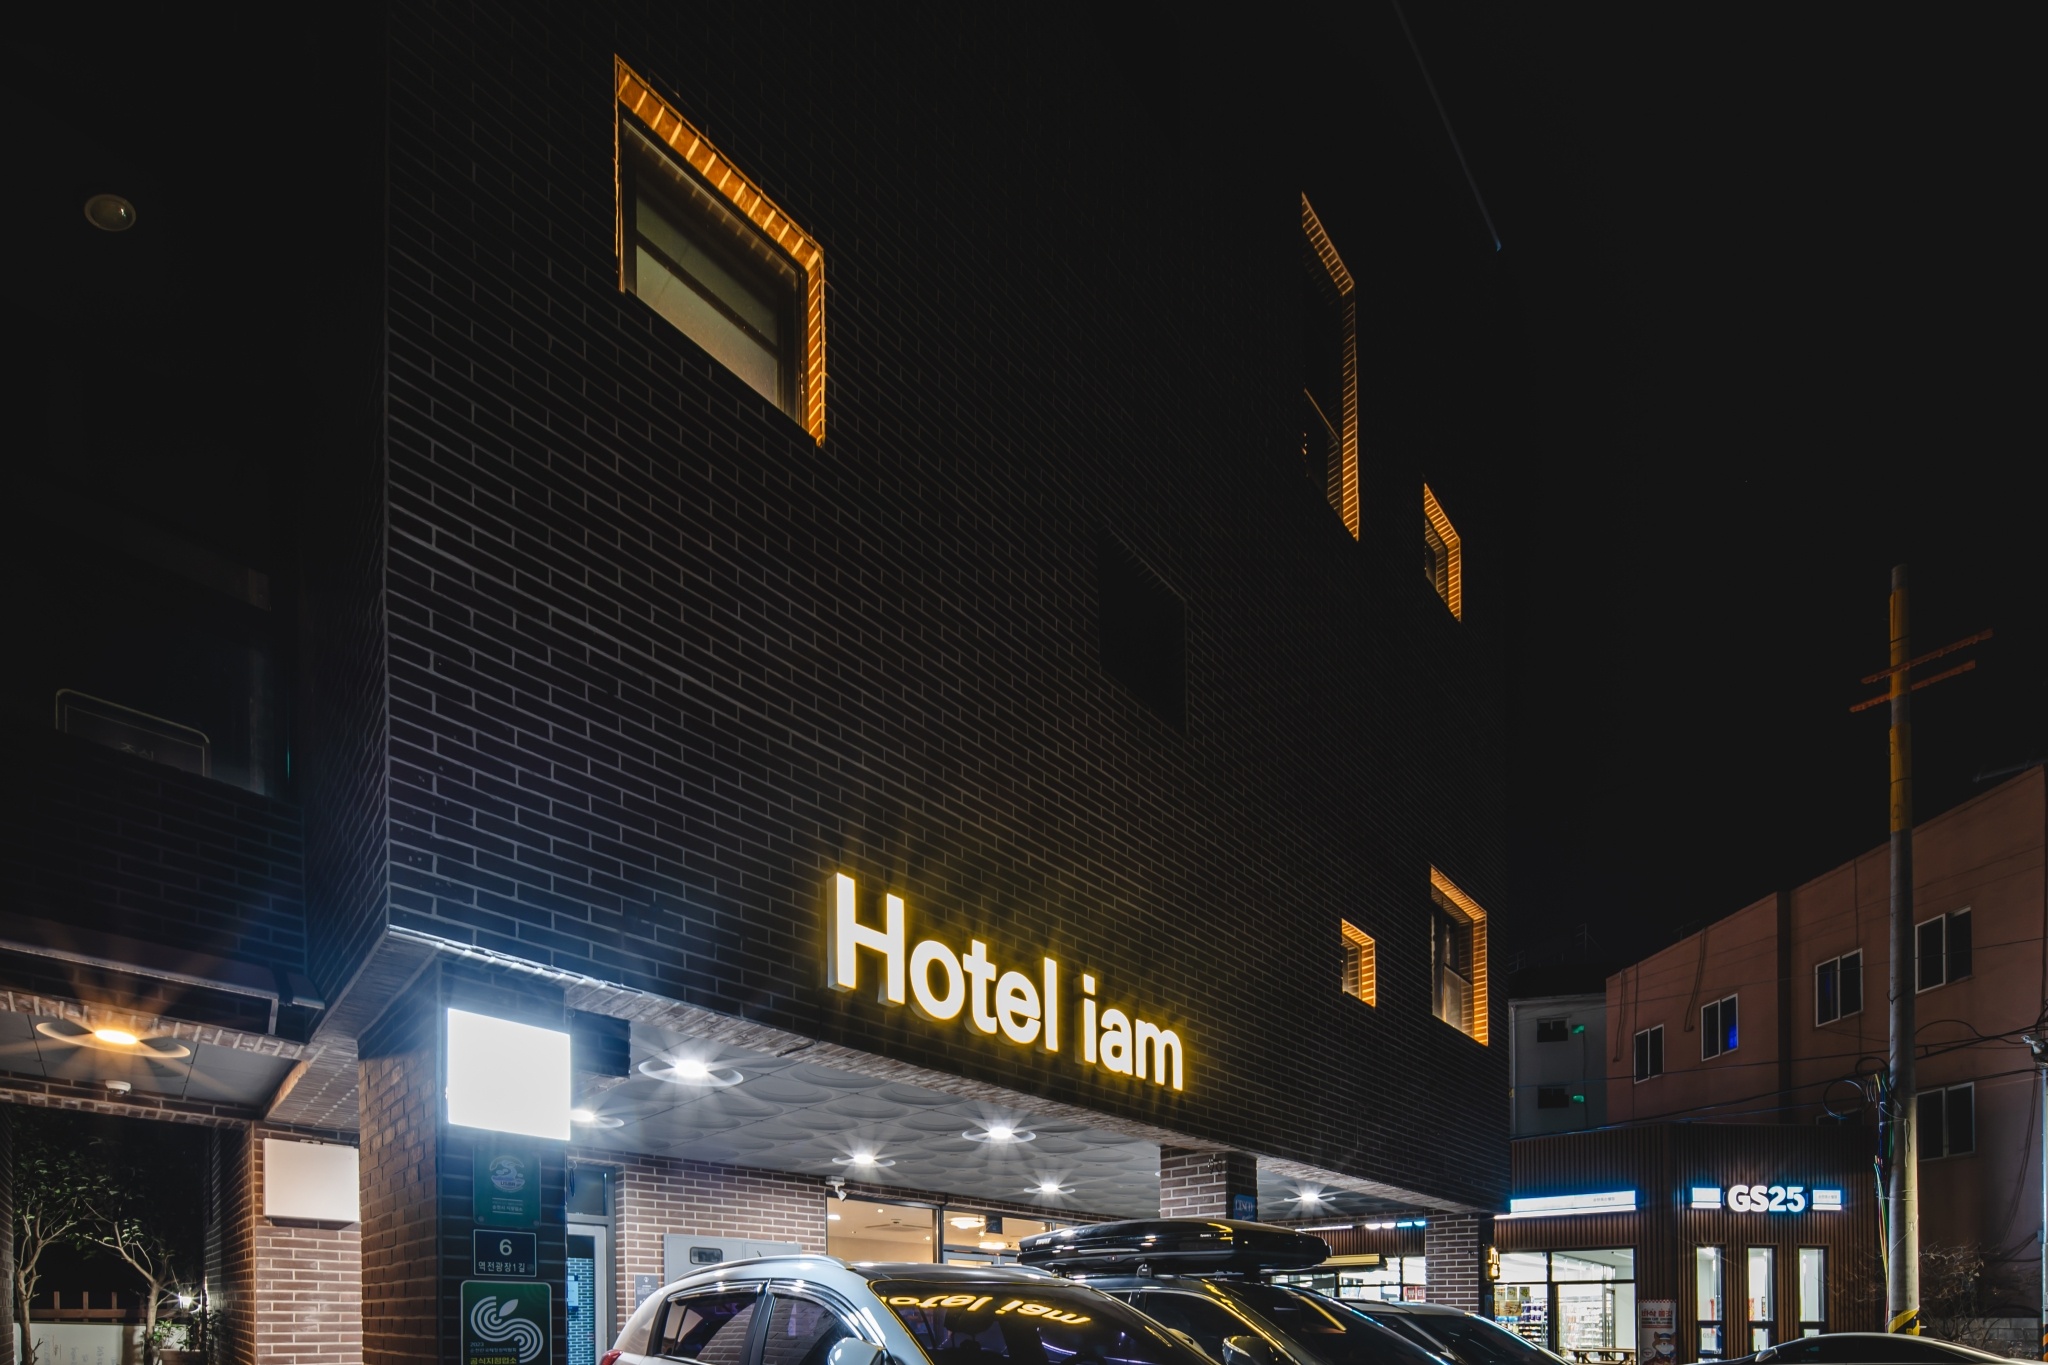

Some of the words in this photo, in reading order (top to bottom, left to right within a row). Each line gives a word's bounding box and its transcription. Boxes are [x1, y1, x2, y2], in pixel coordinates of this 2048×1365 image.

[834, 872, 1059, 1053] Hotel
[1081, 973, 1184, 1092] iam
[1727, 1184, 1806, 1213] GS25
[499, 1239, 513, 1256] 6
[478, 1261, 526, 1273] 역전광장1길
